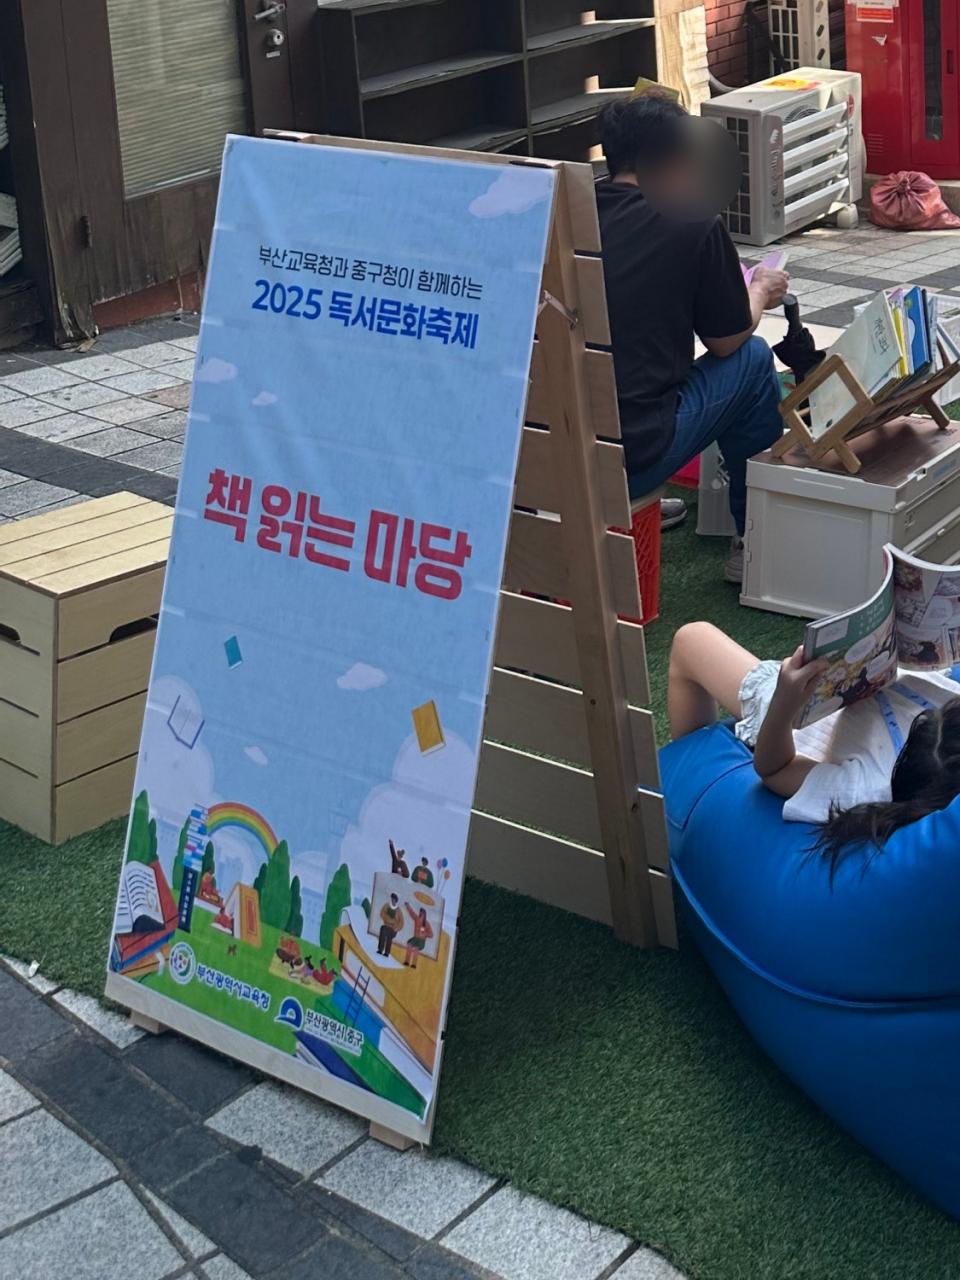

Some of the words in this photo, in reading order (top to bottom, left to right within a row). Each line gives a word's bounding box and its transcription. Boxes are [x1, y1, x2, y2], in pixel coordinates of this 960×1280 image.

[258, 245, 349, 278] 부산교육청과
[351, 259, 415, 289] 중구청이
[416, 269, 484, 301] 함께하는
[251, 279, 324, 321] 2025
[328, 290, 480, 350] 독서문화축제
[203, 468, 253, 543] 책
[256, 484, 356, 572] 읽는
[363, 509, 473, 601] 마당
